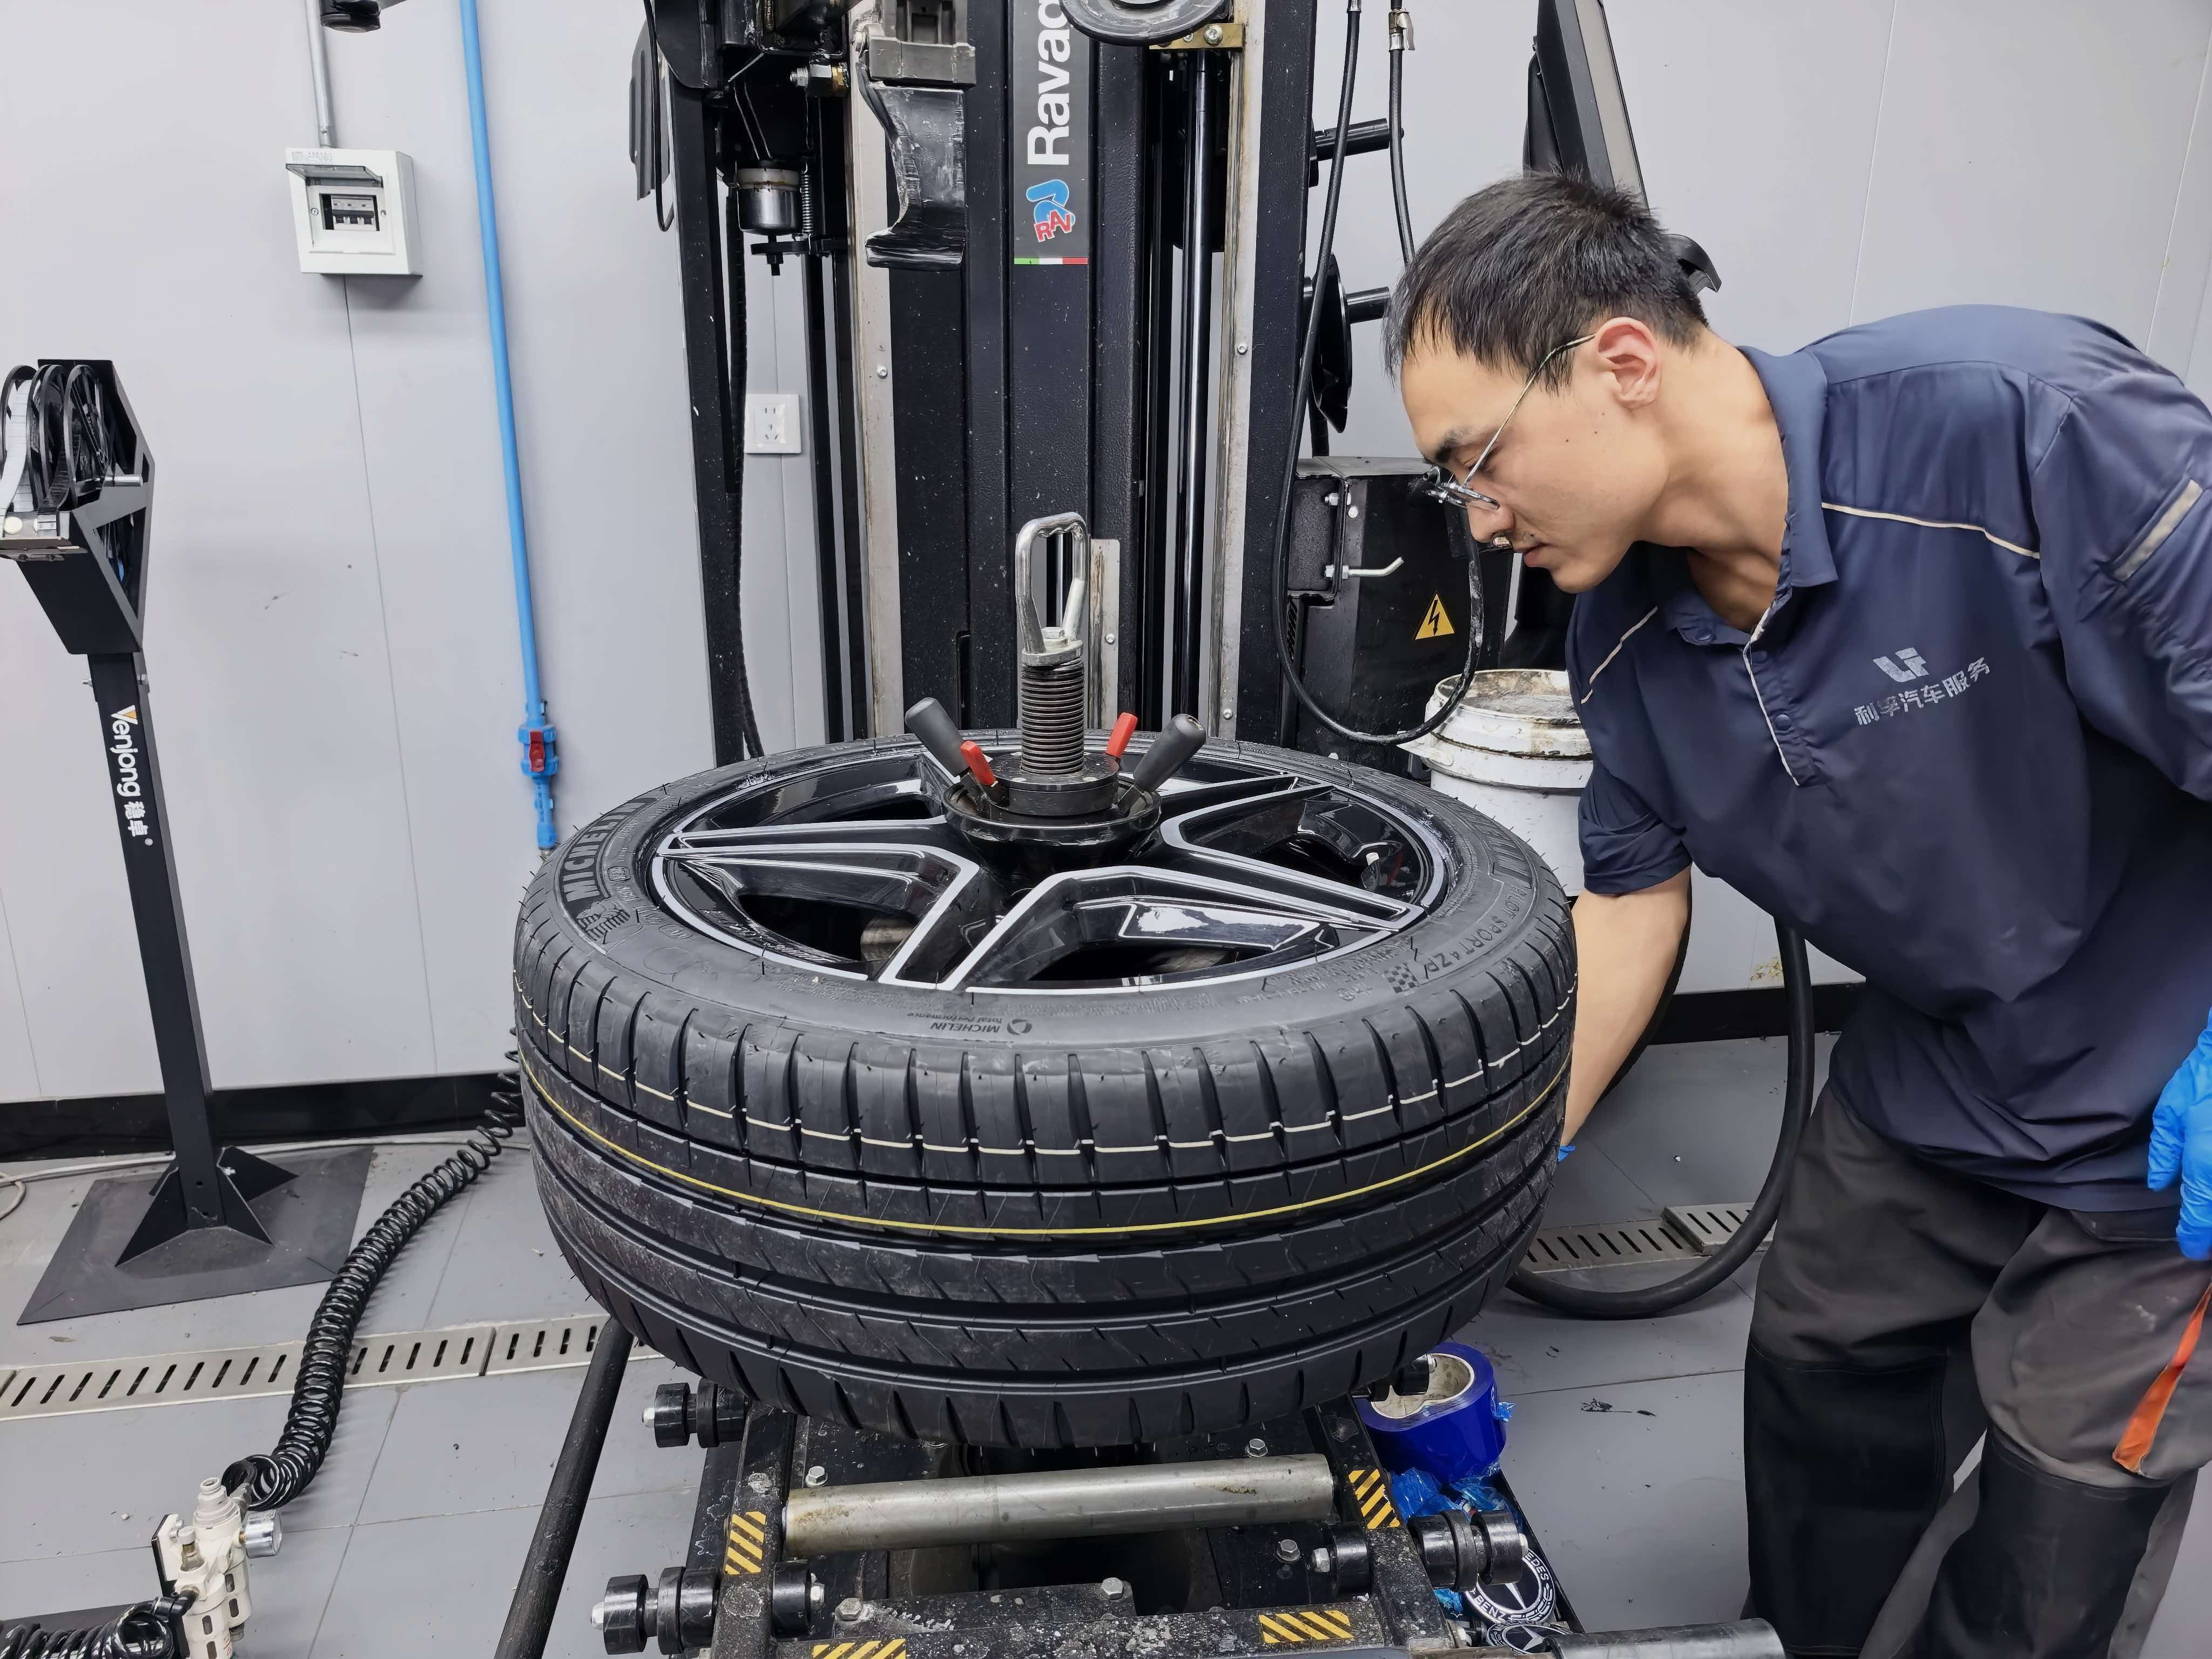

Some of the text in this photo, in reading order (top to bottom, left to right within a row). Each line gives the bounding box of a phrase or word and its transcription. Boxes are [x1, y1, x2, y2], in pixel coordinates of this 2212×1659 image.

[1034, 209, 1072, 242] RAV
[110, 704, 141, 797] Venjong
[562, 802, 646, 903] MICHELIN
[1500, 884, 1528, 920] PILOT
[1459, 915, 1508, 955] SPORT
[907, 1012, 975, 1022] Performance
[929, 1022, 1000, 1033] MICHELIN
[1475, 1594, 1506, 1621] BENZ
